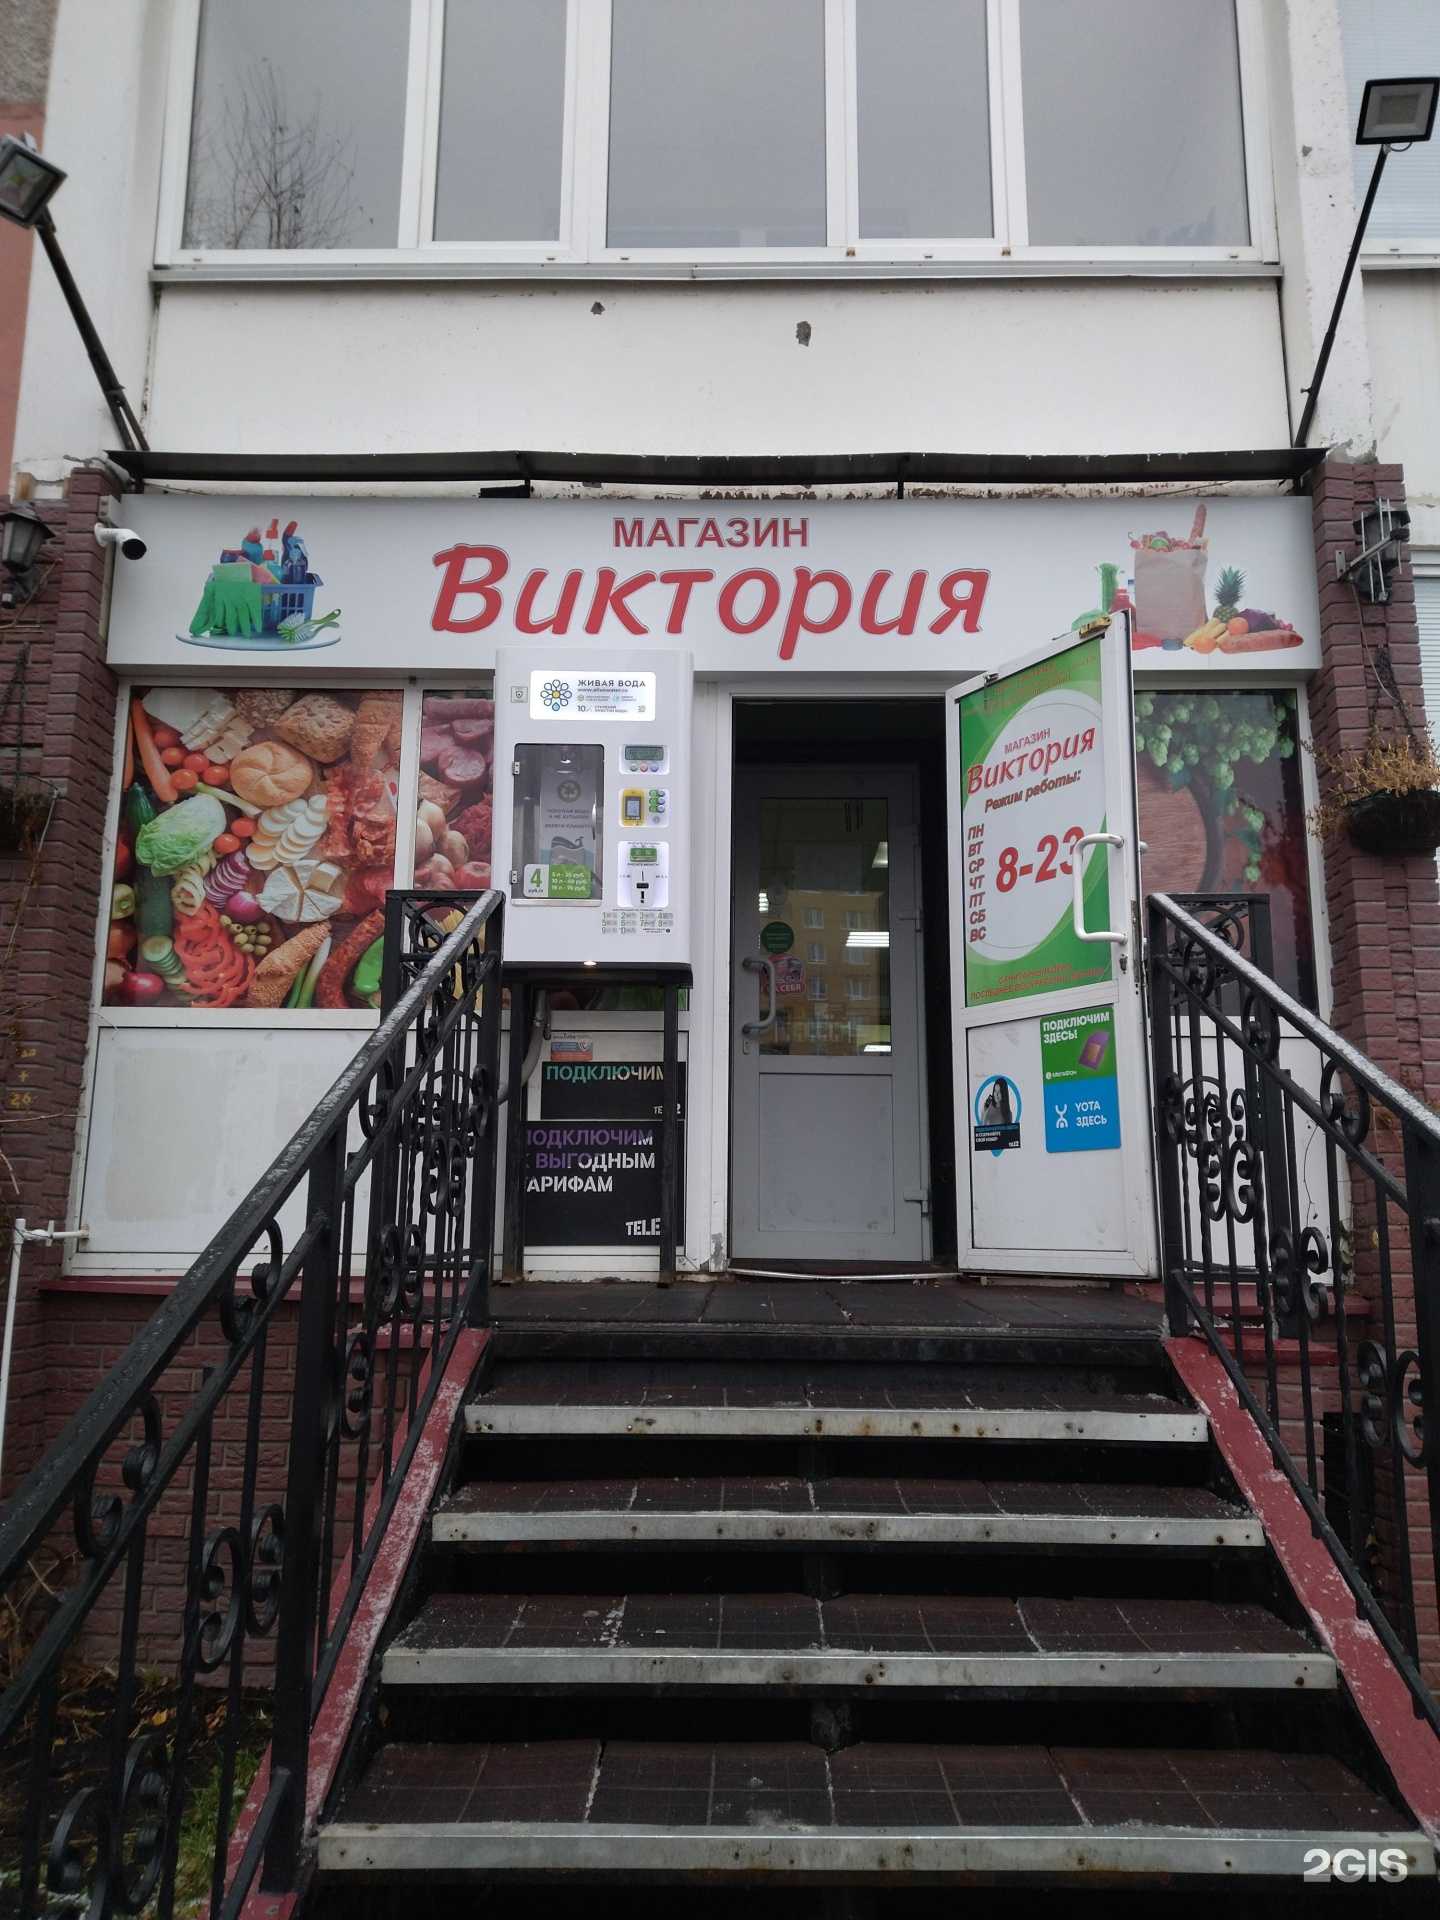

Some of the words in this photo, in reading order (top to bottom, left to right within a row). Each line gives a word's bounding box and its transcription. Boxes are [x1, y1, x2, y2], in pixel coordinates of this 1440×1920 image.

[612, 516, 810, 548] МАГАЗИН
[431, 543, 992, 661] Виктория
[577, 679, 614, 687] ЖИВАЯ
[618, 680, 646, 688] ВОДА
[1005, 728, 1051, 754] МАГАЗИН
[967, 727, 1096, 796] Виктория
[985, 790, 1024, 813] Режим
[1025, 770, 1081, 802] работы:
[968, 824, 985, 841] ПН
[968, 841, 984, 857] ВТ
[968, 858, 985, 874] СР
[530, 868, 543, 888] 4
[969, 875, 985, 890] ЧТ
[969, 892, 986, 909] ПТ
[969, 909, 986, 925] СБ
[970, 926, 986, 943] ВС
[1043, 1012, 1110, 1032] ПОДКЛЮЧИМ
[1043, 1029, 1078, 1044] ЗДЕСЬ!
[1075, 1101, 1101, 1112] YOTA
[1075, 1115, 1108, 1128] ЗДЕСЬ
[535, 1152, 656, 1172] ВЫГОДНЫМ
[526, 1175, 613, 1192] АРИФАМ
[625, 1217, 661, 1236] TELE
